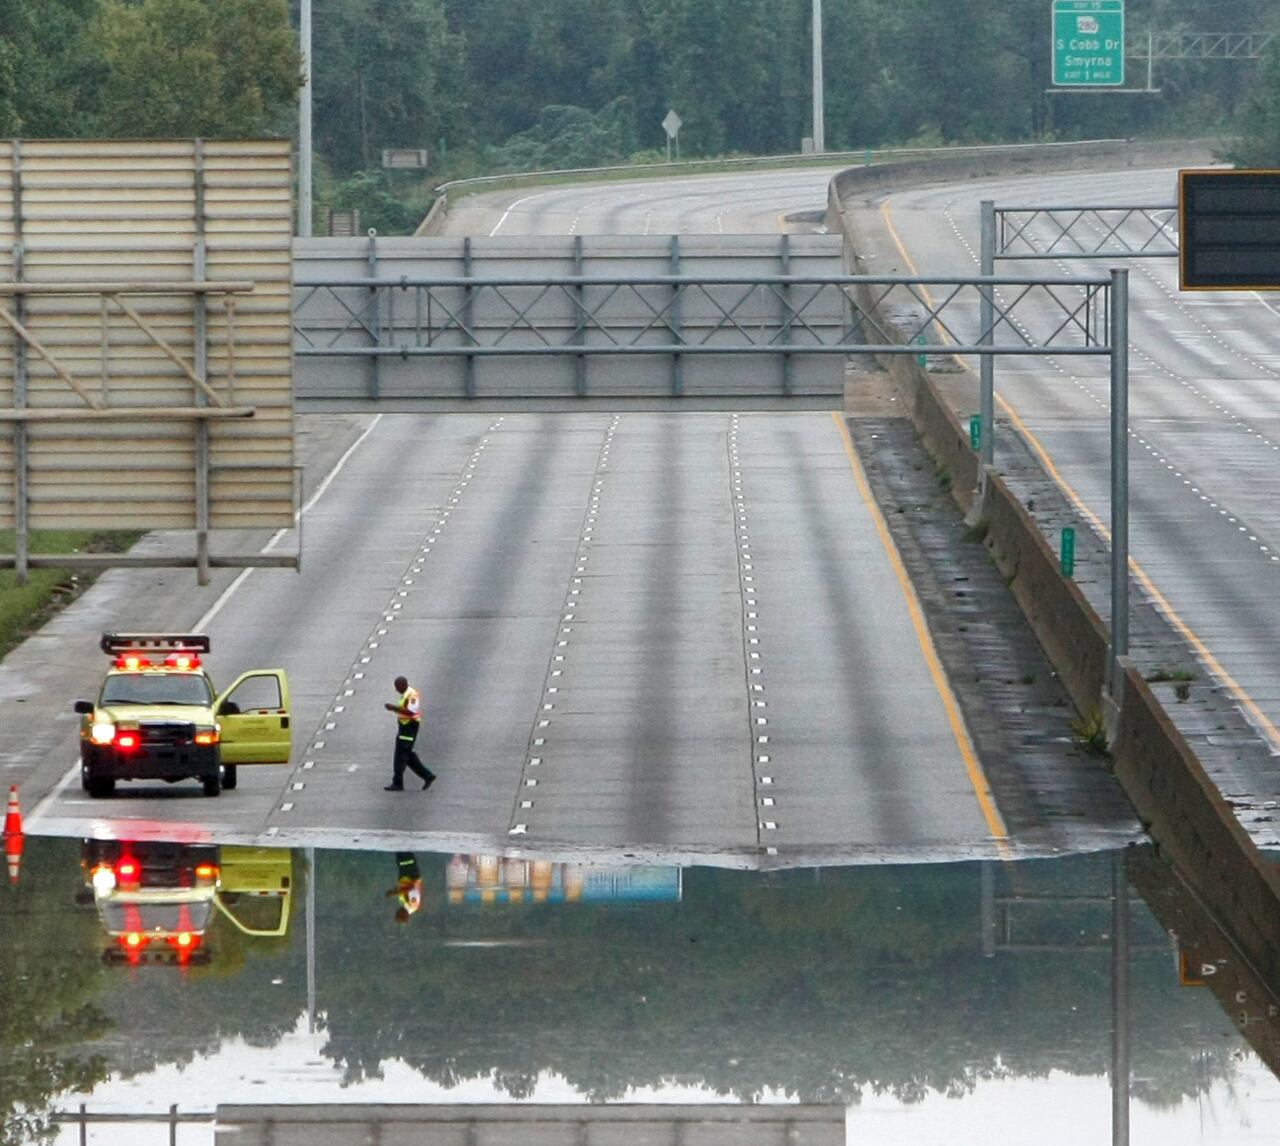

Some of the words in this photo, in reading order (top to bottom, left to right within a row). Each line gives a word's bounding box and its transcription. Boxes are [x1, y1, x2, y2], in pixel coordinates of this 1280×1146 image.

[1056, 39, 1064, 50] S
[1070, 39, 1099, 50] Cobb
[1105, 39, 1119, 50] Dr
[1064, 56, 1112, 68] Smyrna
[1085, 71, 1089, 80] 1
